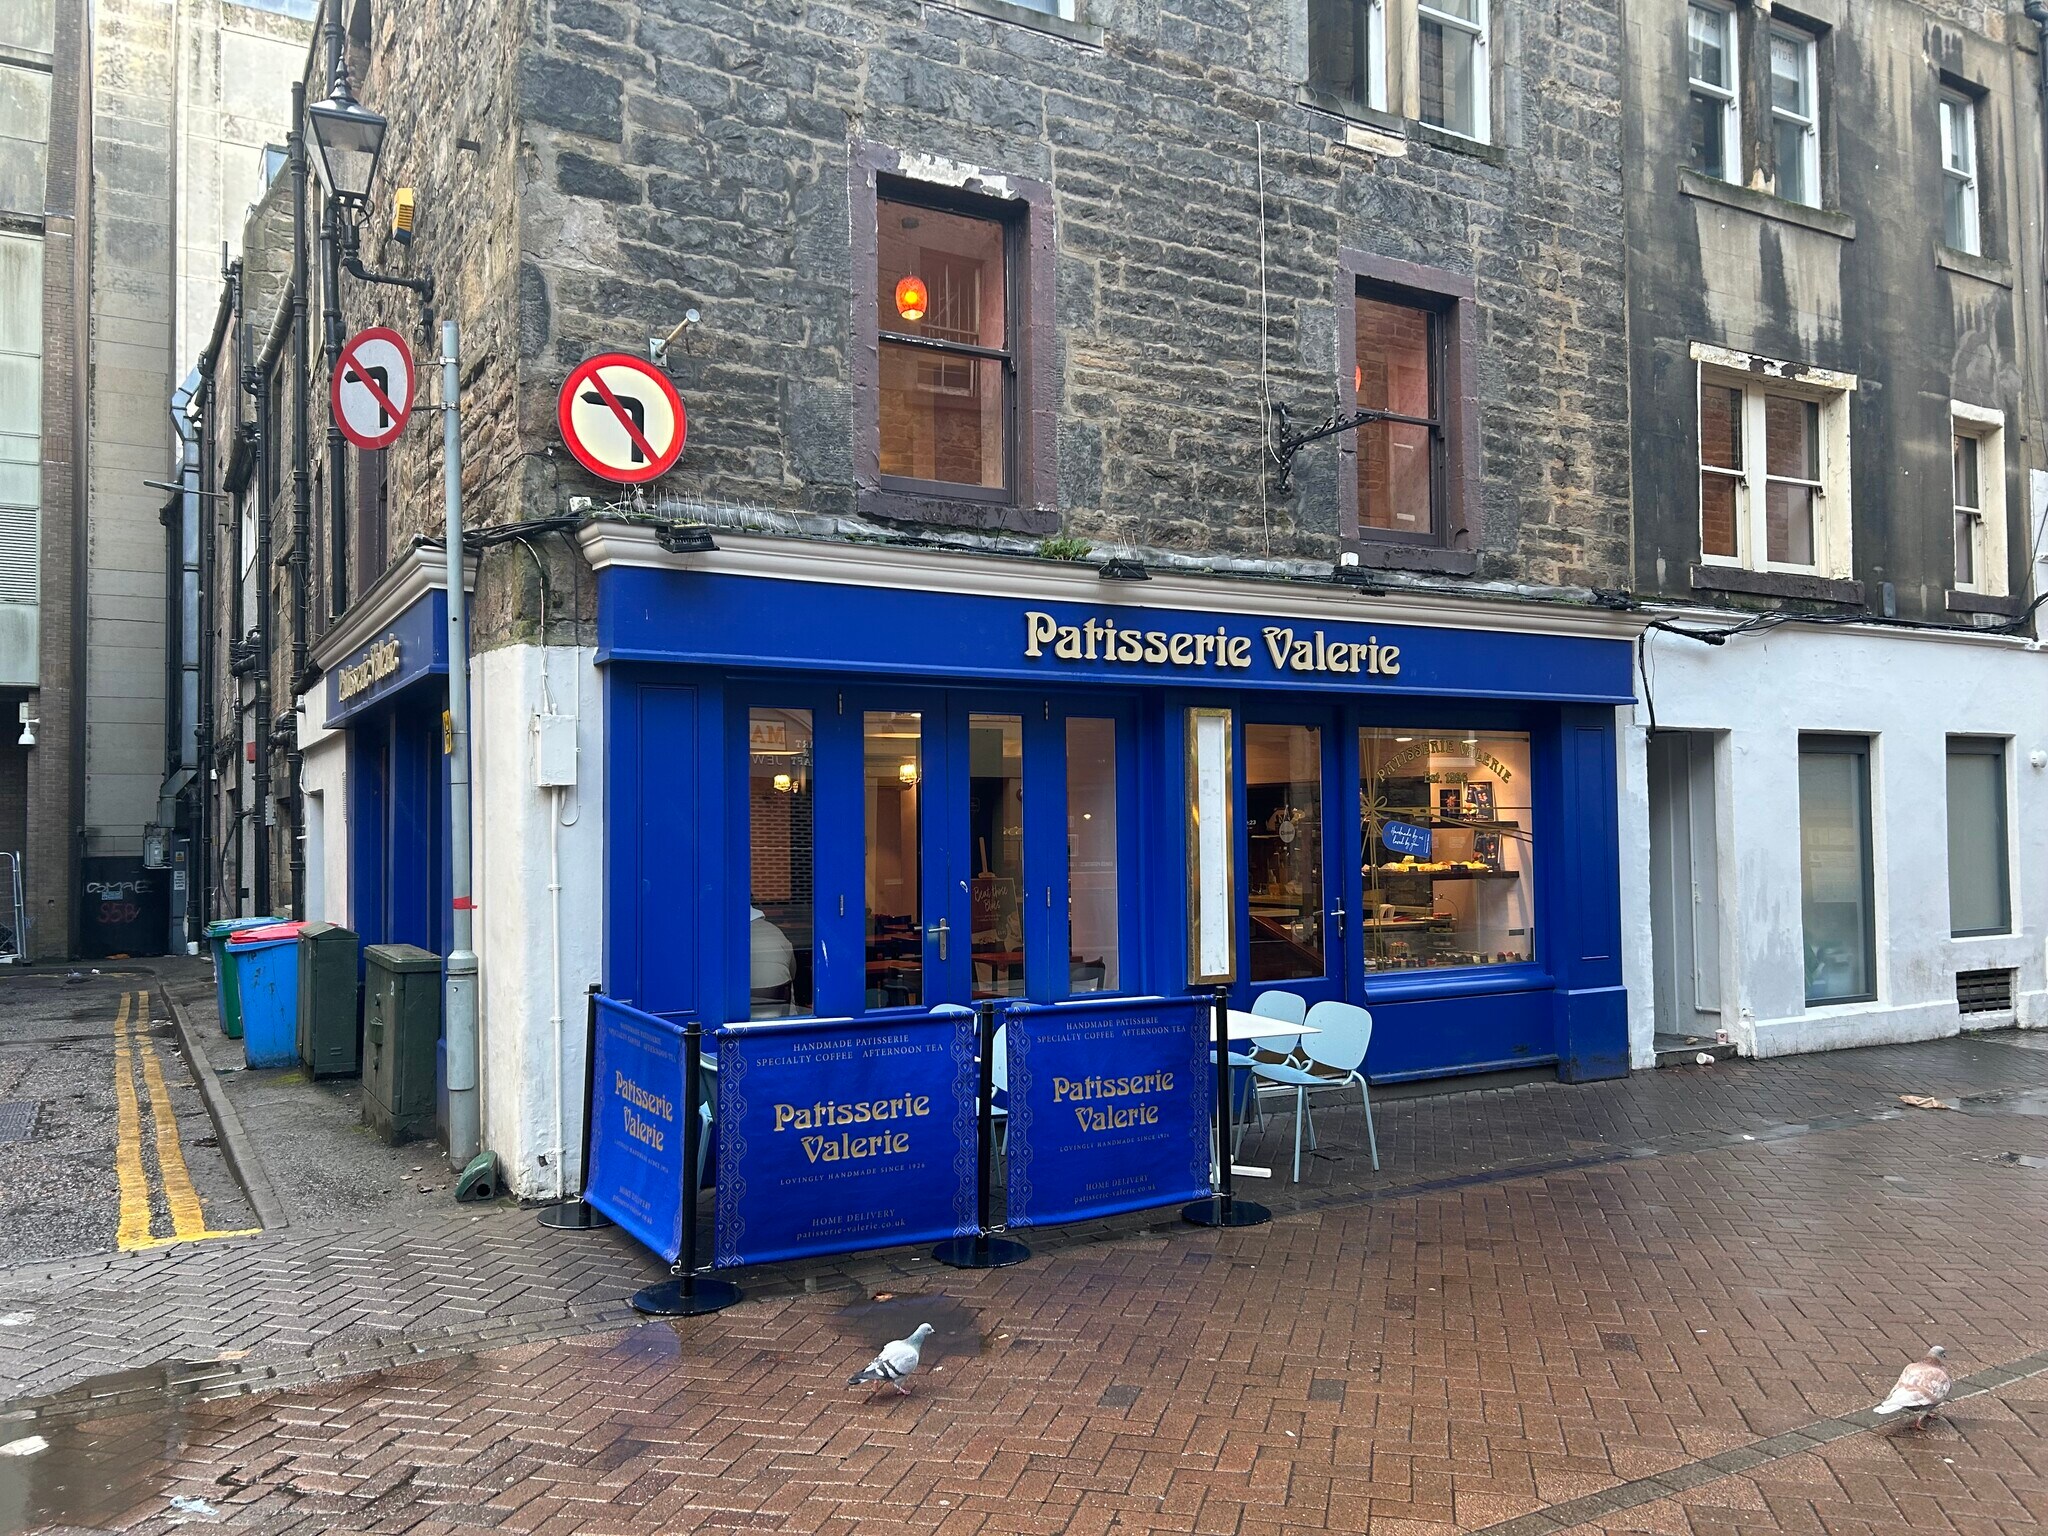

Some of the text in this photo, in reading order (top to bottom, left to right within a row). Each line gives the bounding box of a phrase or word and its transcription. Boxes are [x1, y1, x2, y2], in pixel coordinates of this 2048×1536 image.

[1024, 611, 1400, 675] Patisserie Valerie
[1376, 740, 1512, 784] PATISSERIE VALERIE
[1036, 1025, 1186, 1043] SPECIALTY COFFEE AFTERNOON TEA
[1066, 1016, 1159, 1030] HANDMADE PATISSERIE
[756, 1043, 943, 1067] SPECIALTY COFFEE AFTERNOON TEA
[793, 1034, 909, 1052] HANDMADE PATISSERIE
[615, 1070, 673, 1122] Patisserie
[1052, 1069, 1174, 1103] Patisserie
[773, 1092, 930, 1132] Patisserie
[1074, 1103, 1159, 1133] Valerie
[623, 1106, 664, 1151] Valerie
[1137, 1134, 1155, 1142] SINCE
[800, 1129, 910, 1164] Valerie
[780, 1174, 824, 1185] LOVINGLY
[828, 1168, 877, 1180] HANDMADE
[880, 1164, 905, 1173] SINCE
[1085, 1174, 1149, 1191] HOME DELIVERY
[812, 1208, 895, 1226] HOME DELIVERY
[796, 1218, 906, 1241] patisserie-valerie.co.uk
